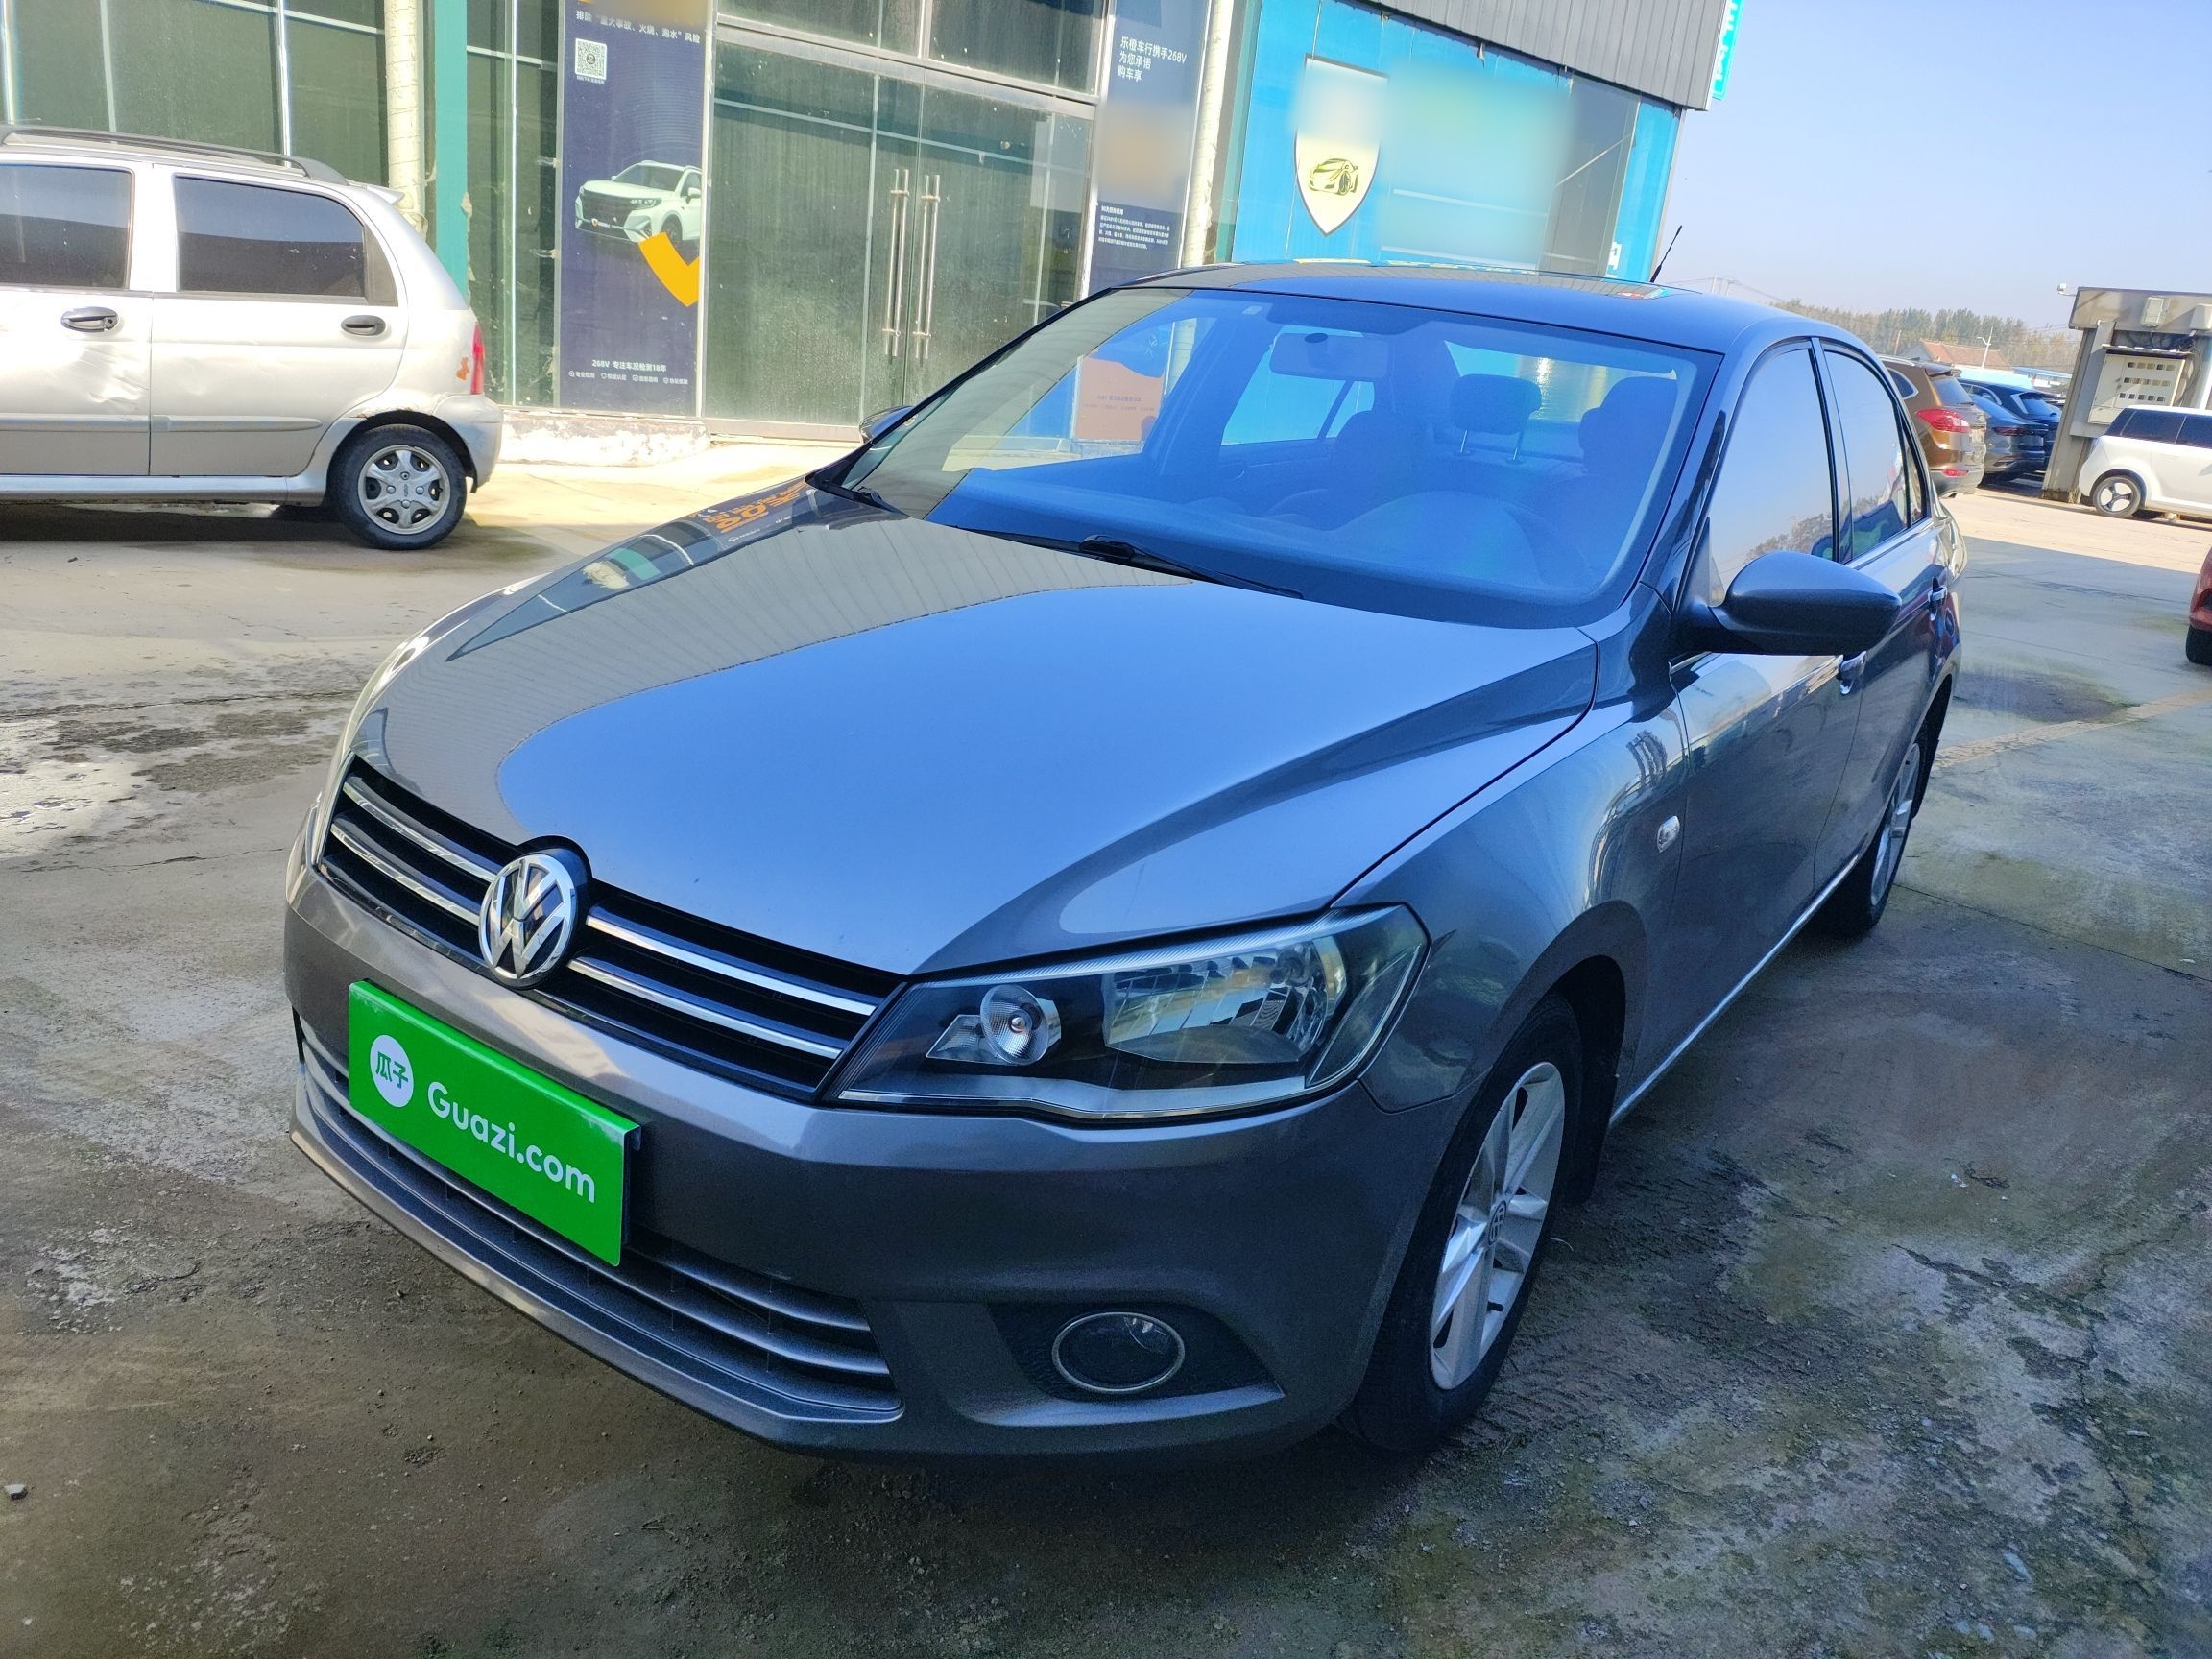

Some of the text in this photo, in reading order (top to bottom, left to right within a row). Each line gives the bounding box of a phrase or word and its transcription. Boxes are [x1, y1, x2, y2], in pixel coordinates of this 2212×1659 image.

[1118, 65, 1142, 81] 购车享
[1119, 51, 1151, 69] 为您承诺
[375, 1051, 409, 1089] 瓜子
[427, 1081, 595, 1203] Guazi.com
